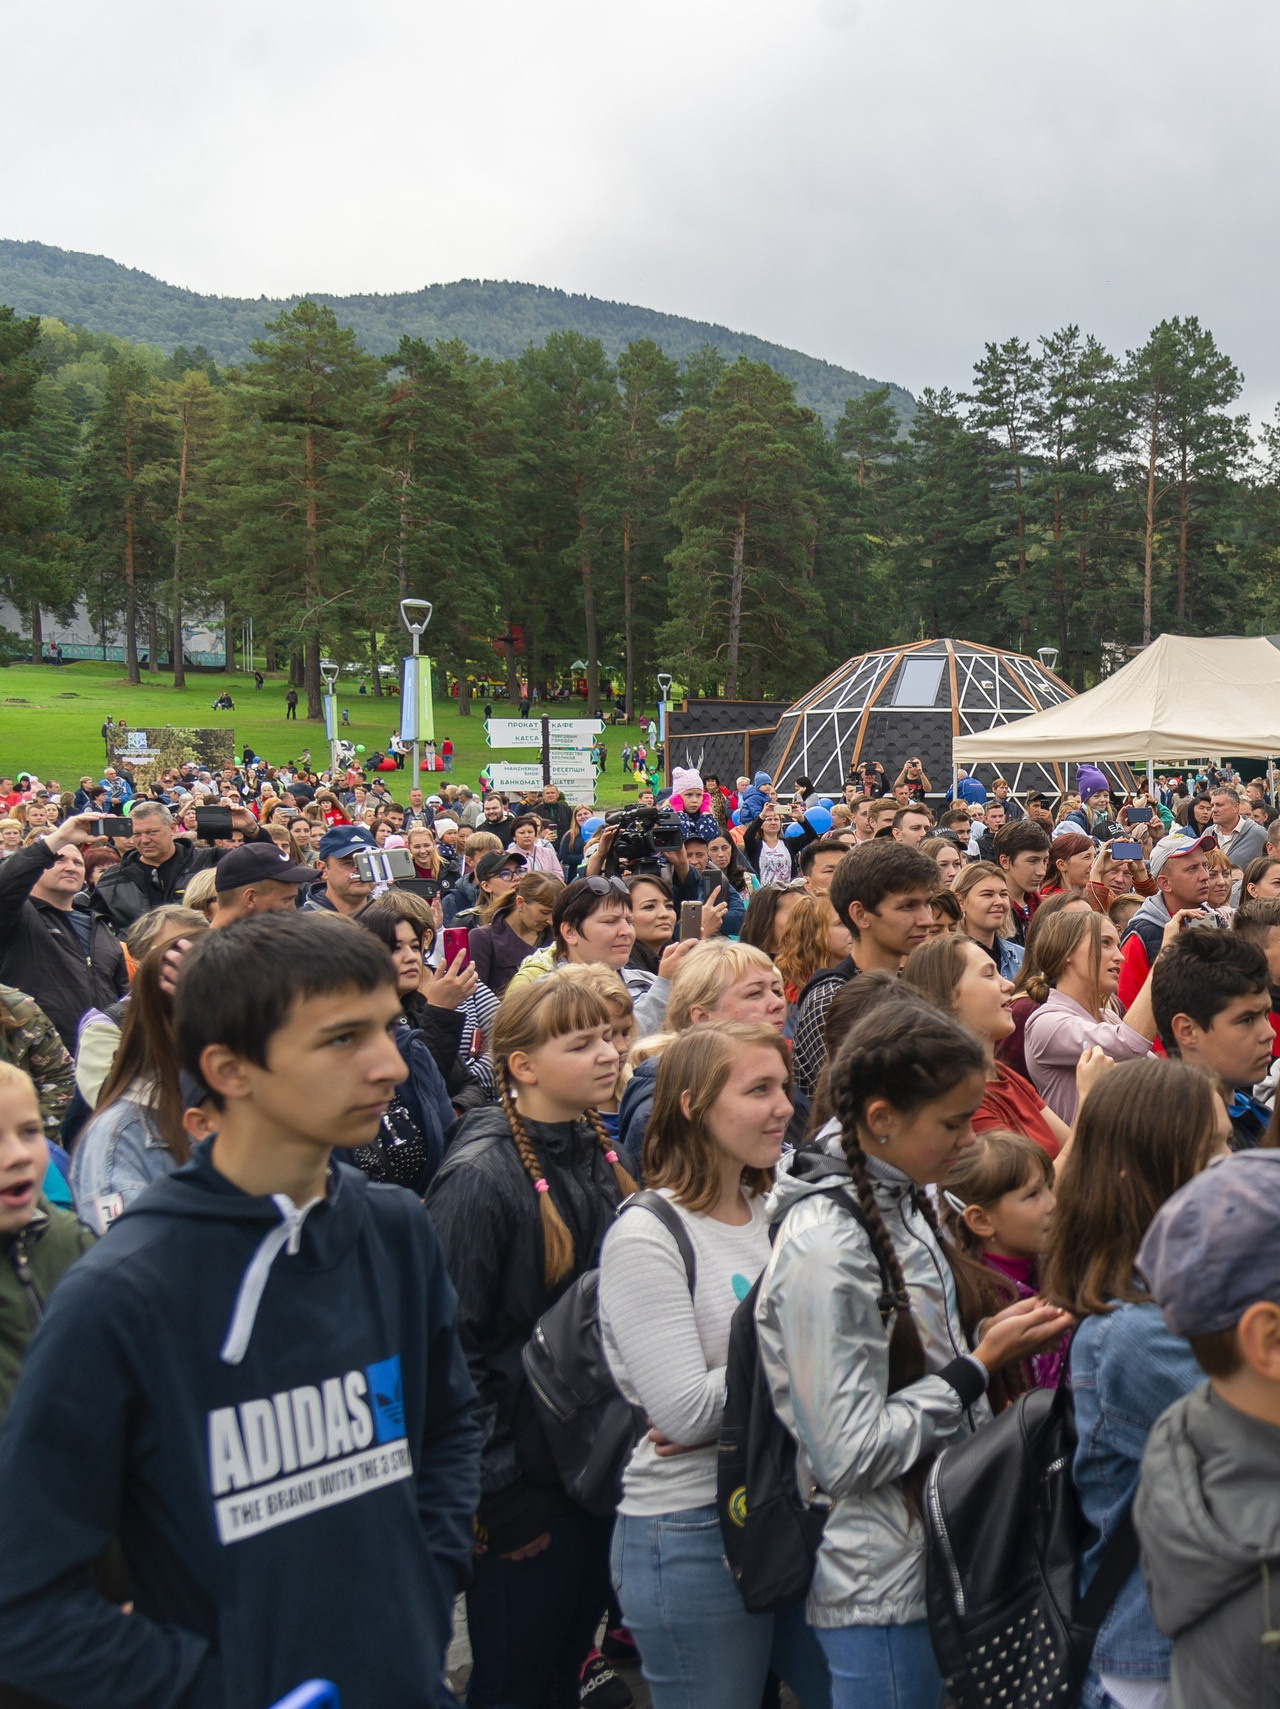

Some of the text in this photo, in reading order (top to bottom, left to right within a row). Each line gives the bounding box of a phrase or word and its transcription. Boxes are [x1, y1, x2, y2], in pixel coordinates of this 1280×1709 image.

[208, 1370, 373, 1495] ADIDAS
[230, 1498, 266, 1528] THE
[267, 1478, 317, 1516] BRAND
[318, 1464, 357, 1496] WITH
[357, 1457, 379, 1480] THE
[381, 1454, 390, 1475] 3
